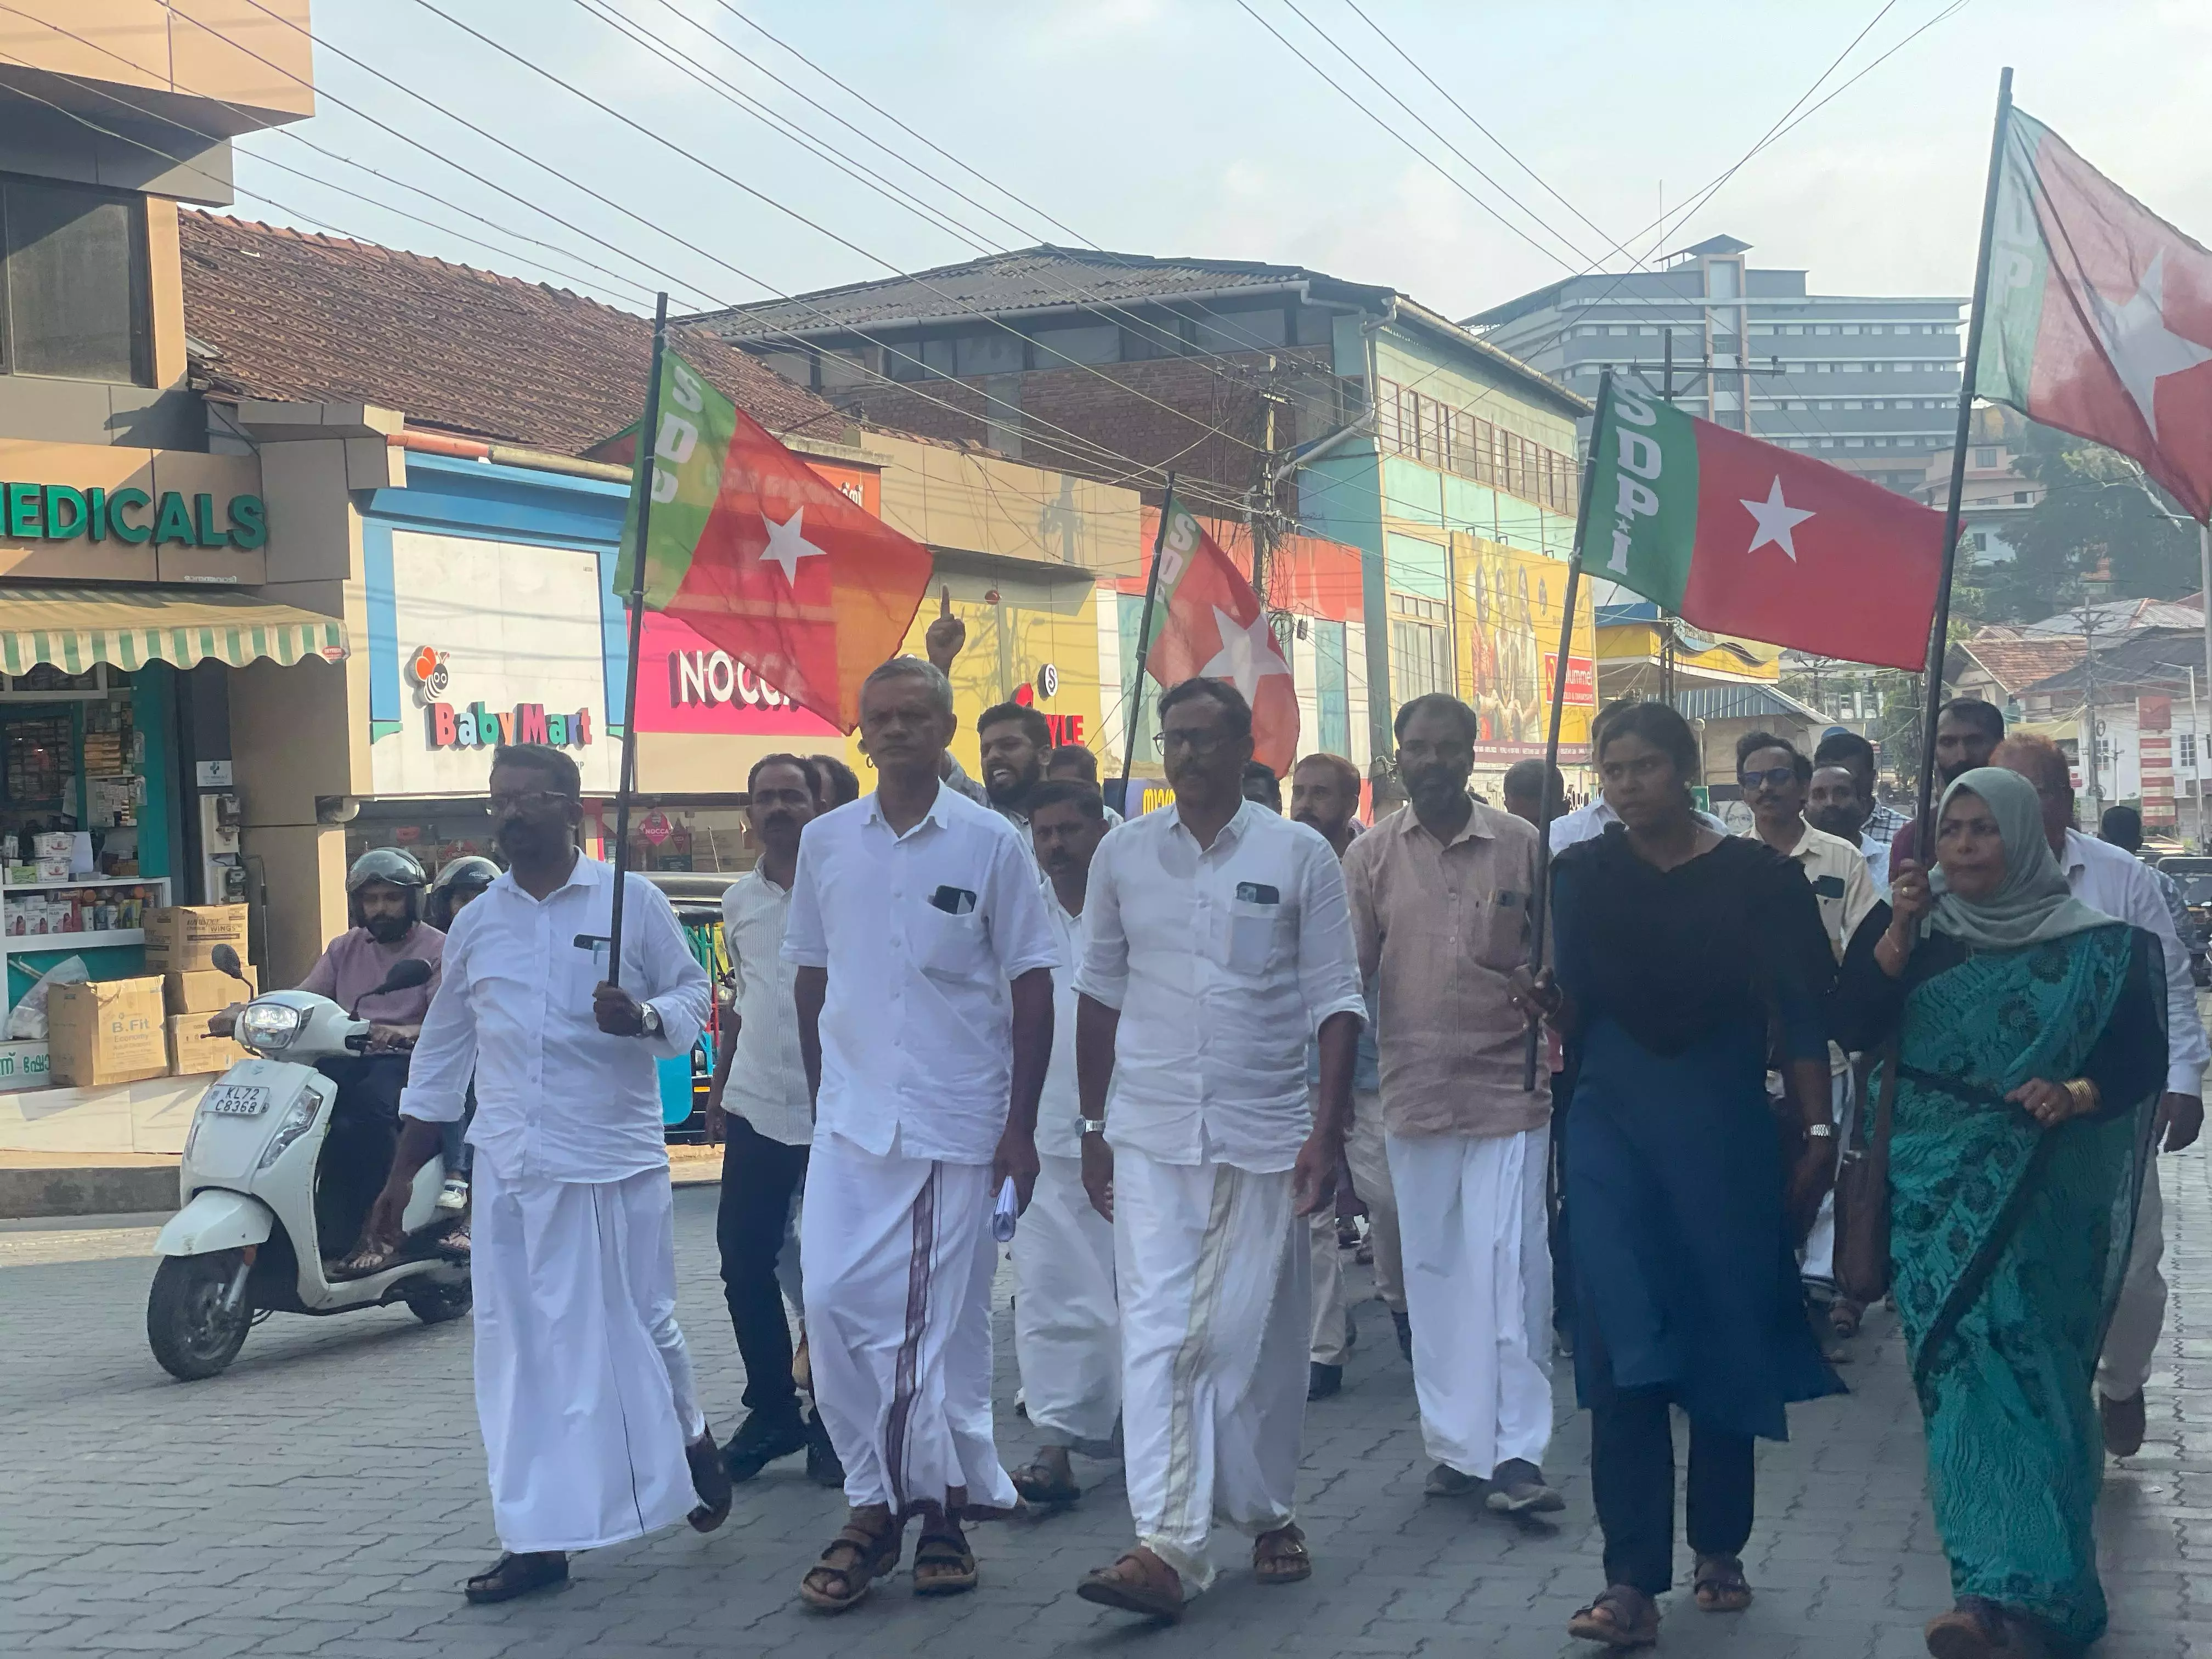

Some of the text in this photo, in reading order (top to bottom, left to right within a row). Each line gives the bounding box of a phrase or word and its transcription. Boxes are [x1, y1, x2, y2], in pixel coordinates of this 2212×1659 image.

[1606, 375, 1662, 576] SDPI
[0, 481, 268, 549] EDICALS
[678, 649, 791, 707] NOCC
[1046, 715, 1085, 749] YLE
[114, 1034, 149, 1042] Economy
[215, 1099, 257, 1113] C8368
[225, 1087, 259, 1100] KL72
